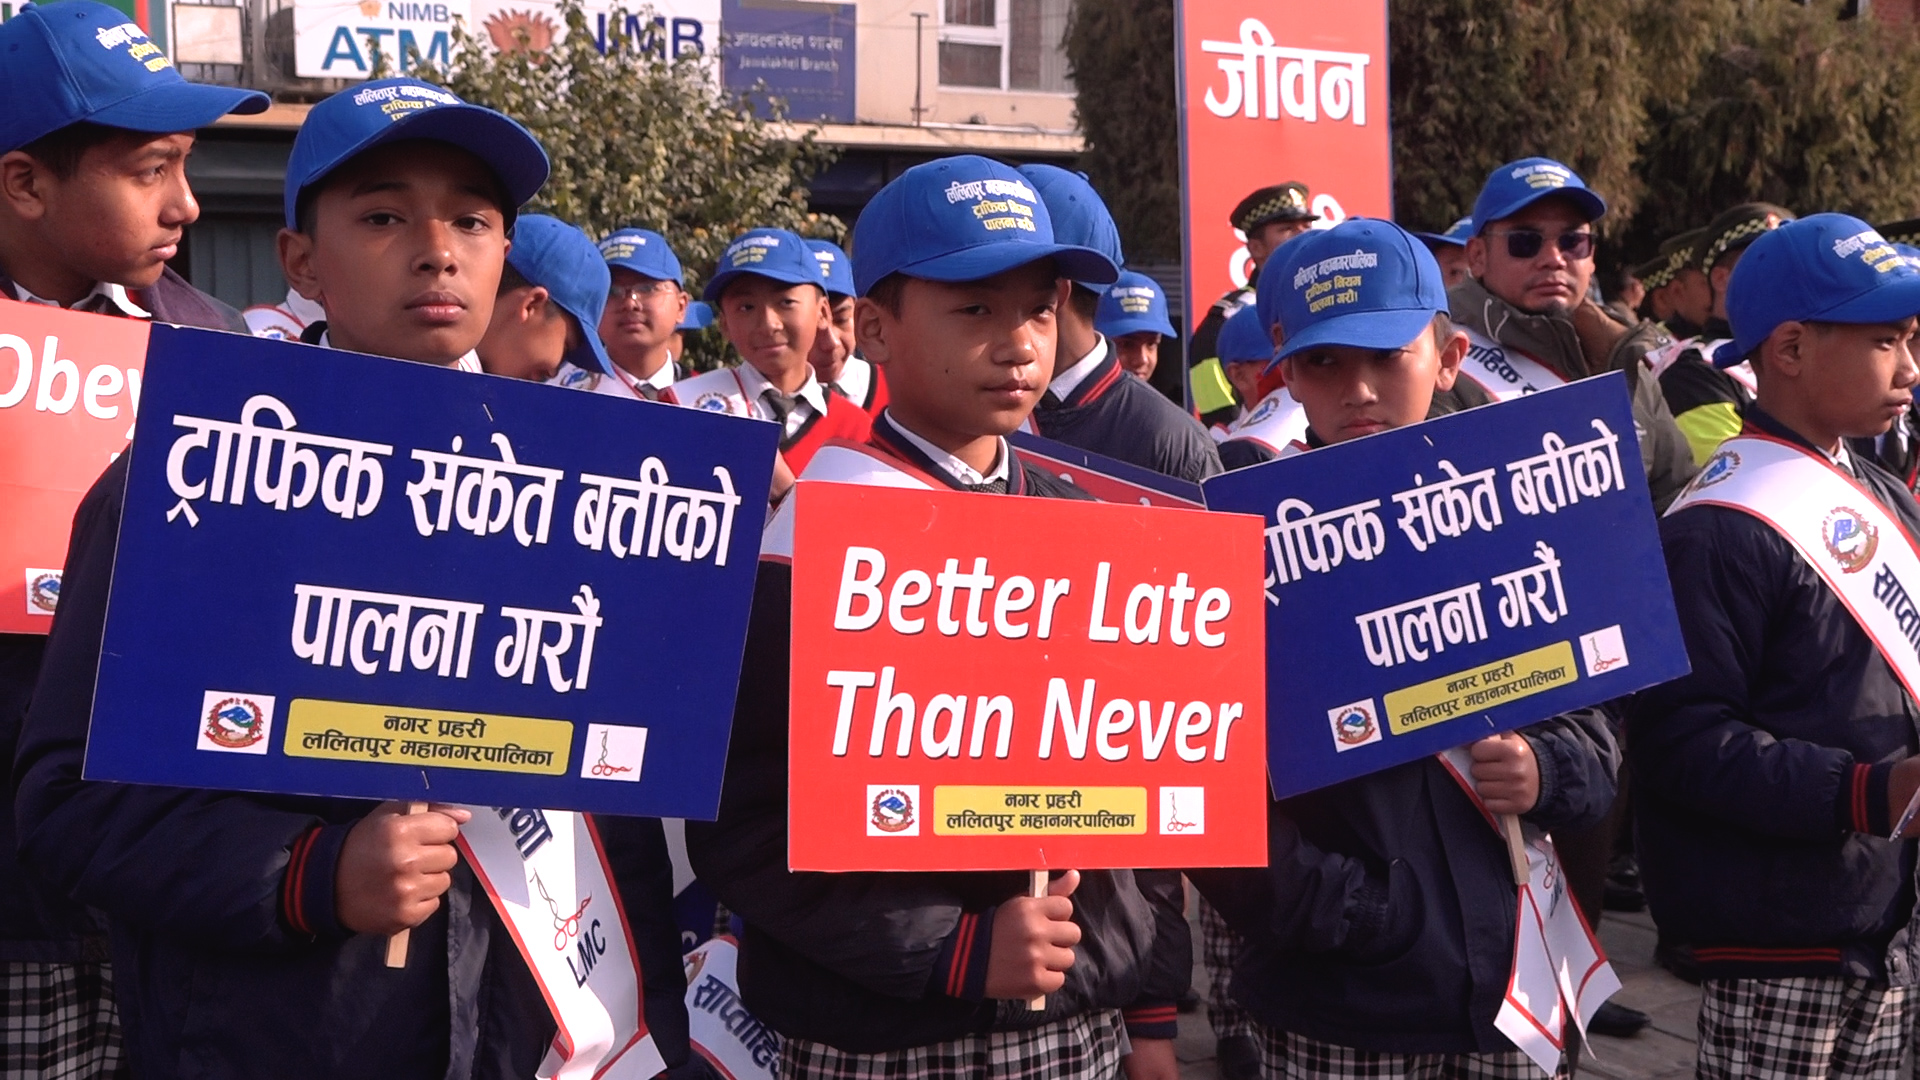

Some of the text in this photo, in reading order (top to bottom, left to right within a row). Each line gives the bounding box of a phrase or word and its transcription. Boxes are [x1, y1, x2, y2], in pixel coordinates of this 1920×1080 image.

[388, 2, 450, 23] NIMB
[580, 12, 705, 60] MB
[321, 25, 450, 76] ATM
[800, 57, 839, 72] Branch
[1200, 17, 1371, 126] जीवन
[165, 394, 742, 566] ट्राफिक संकेत बत्तीको
[1391, 460, 1504, 552] संकेत
[1505, 418, 1626, 515] बत्तीको
[833, 546, 1232, 647] Better Late
[1355, 582, 1488, 668] पालना
[291, 583, 485, 679] पालना
[1399, 666, 1566, 727] ललितपुर महानगरपालिका
[1446, 662, 1515, 694] नगर प्रहरी
[383, 715, 487, 739] नगर प्रहरी
[826, 666, 1244, 762] Than Never
[302, 728, 554, 767] ललितपुर महानगरपालिका
[946, 809, 1136, 832] ललितपुर महानगरपालिका
[1004, 790, 1083, 809] नगर प्रहरी
[566, 918, 606, 989] LMC
[693, 973, 780, 1080] साप्ताहि
